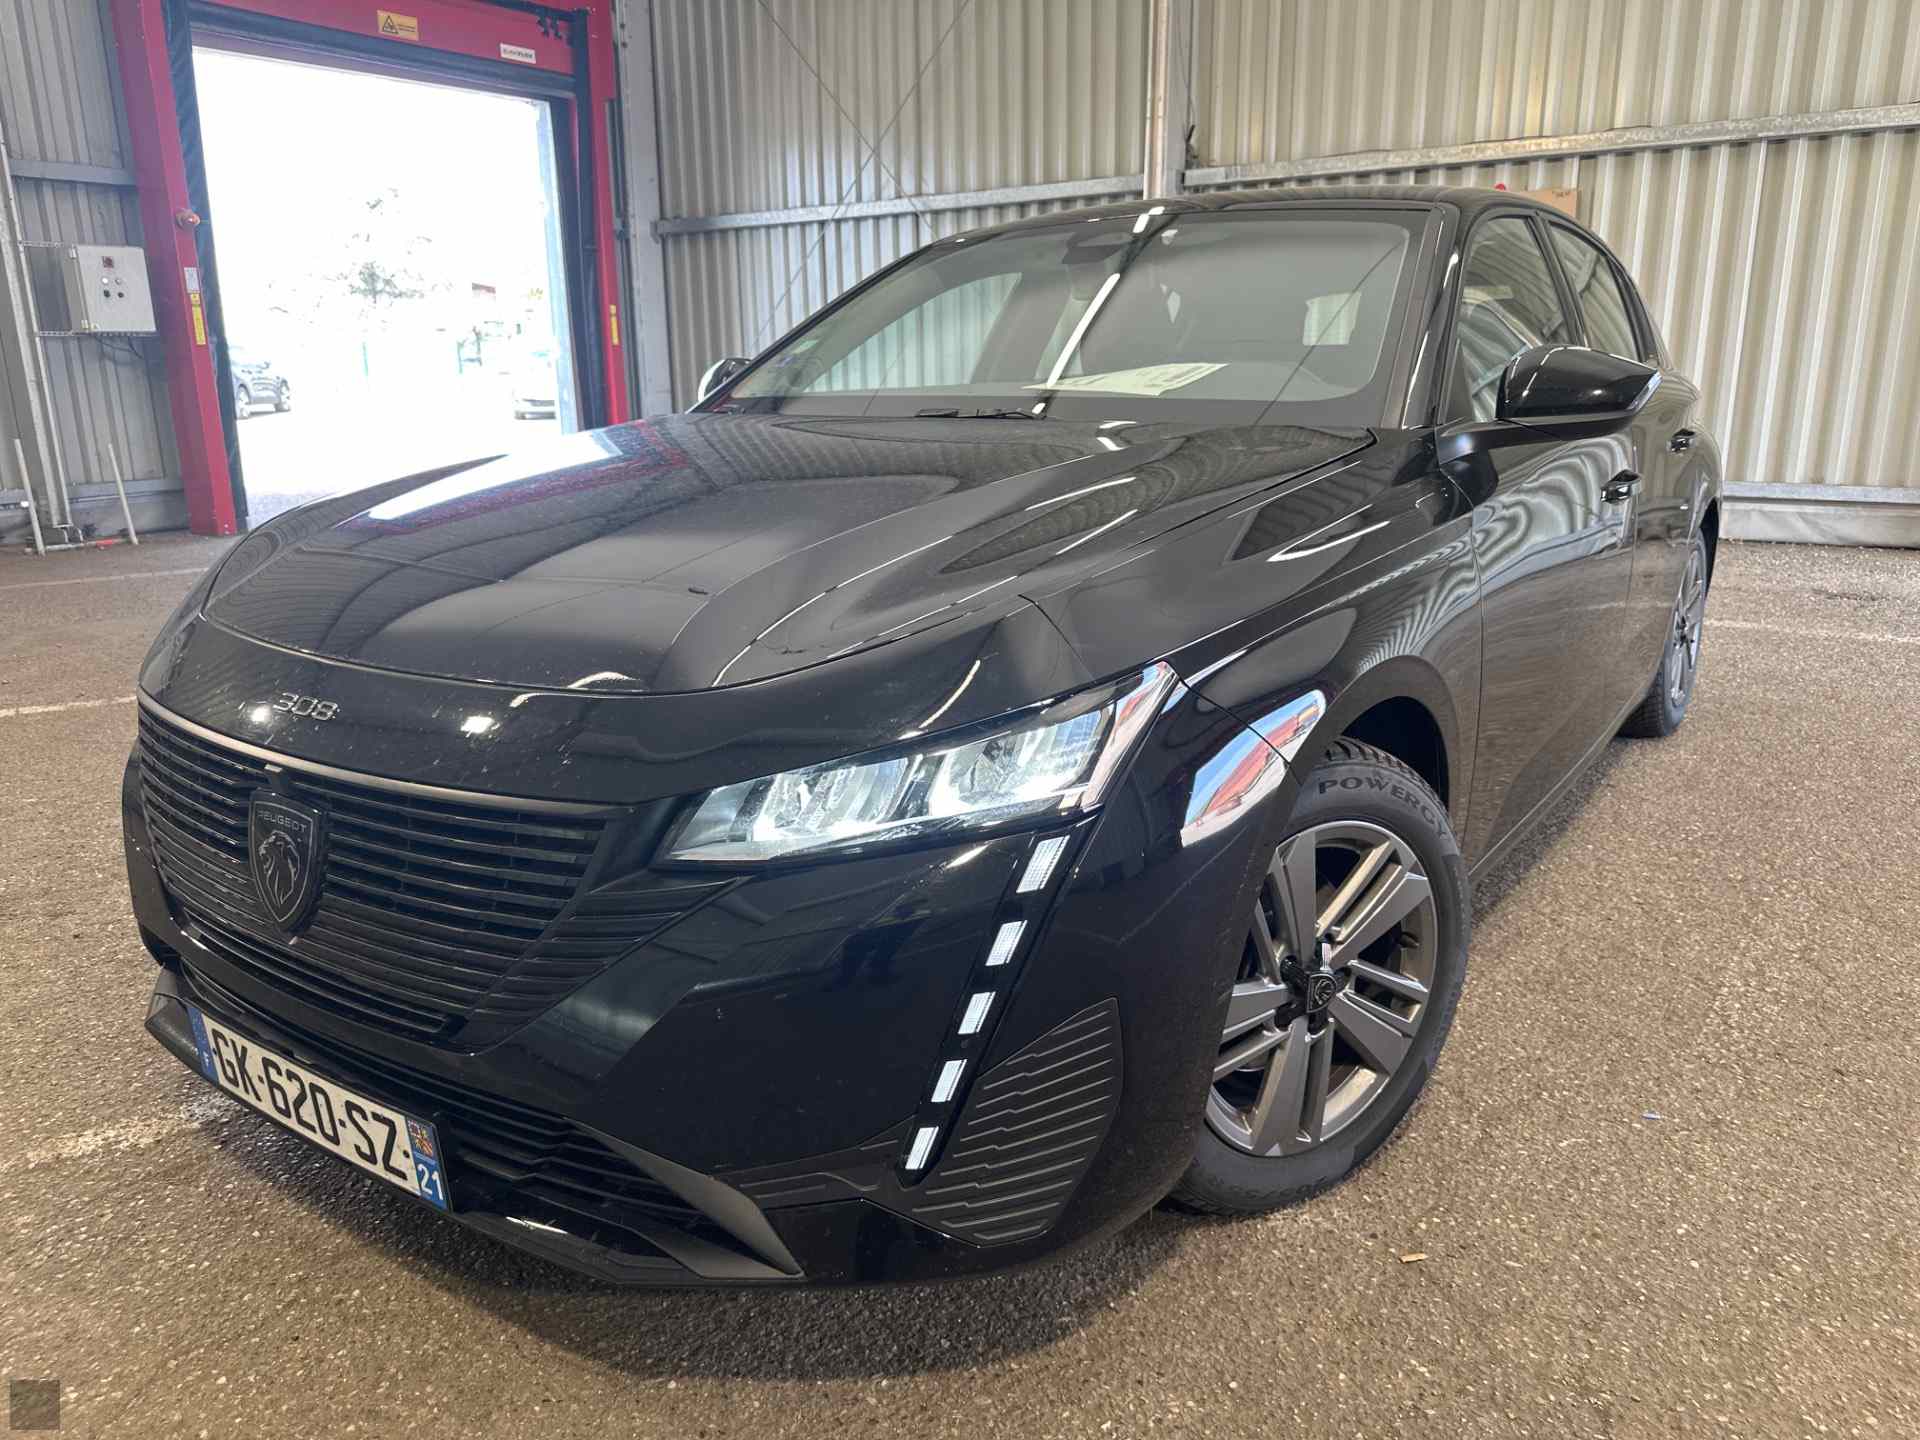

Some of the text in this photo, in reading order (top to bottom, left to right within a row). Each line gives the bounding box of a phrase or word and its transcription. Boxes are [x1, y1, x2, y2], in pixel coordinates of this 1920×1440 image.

[273, 692, 338, 721] 308
[257, 809, 307, 832] PEUGEOT
[211, 1028, 408, 1181] GK-620-SZ
[417, 1163, 443, 1201] 21
